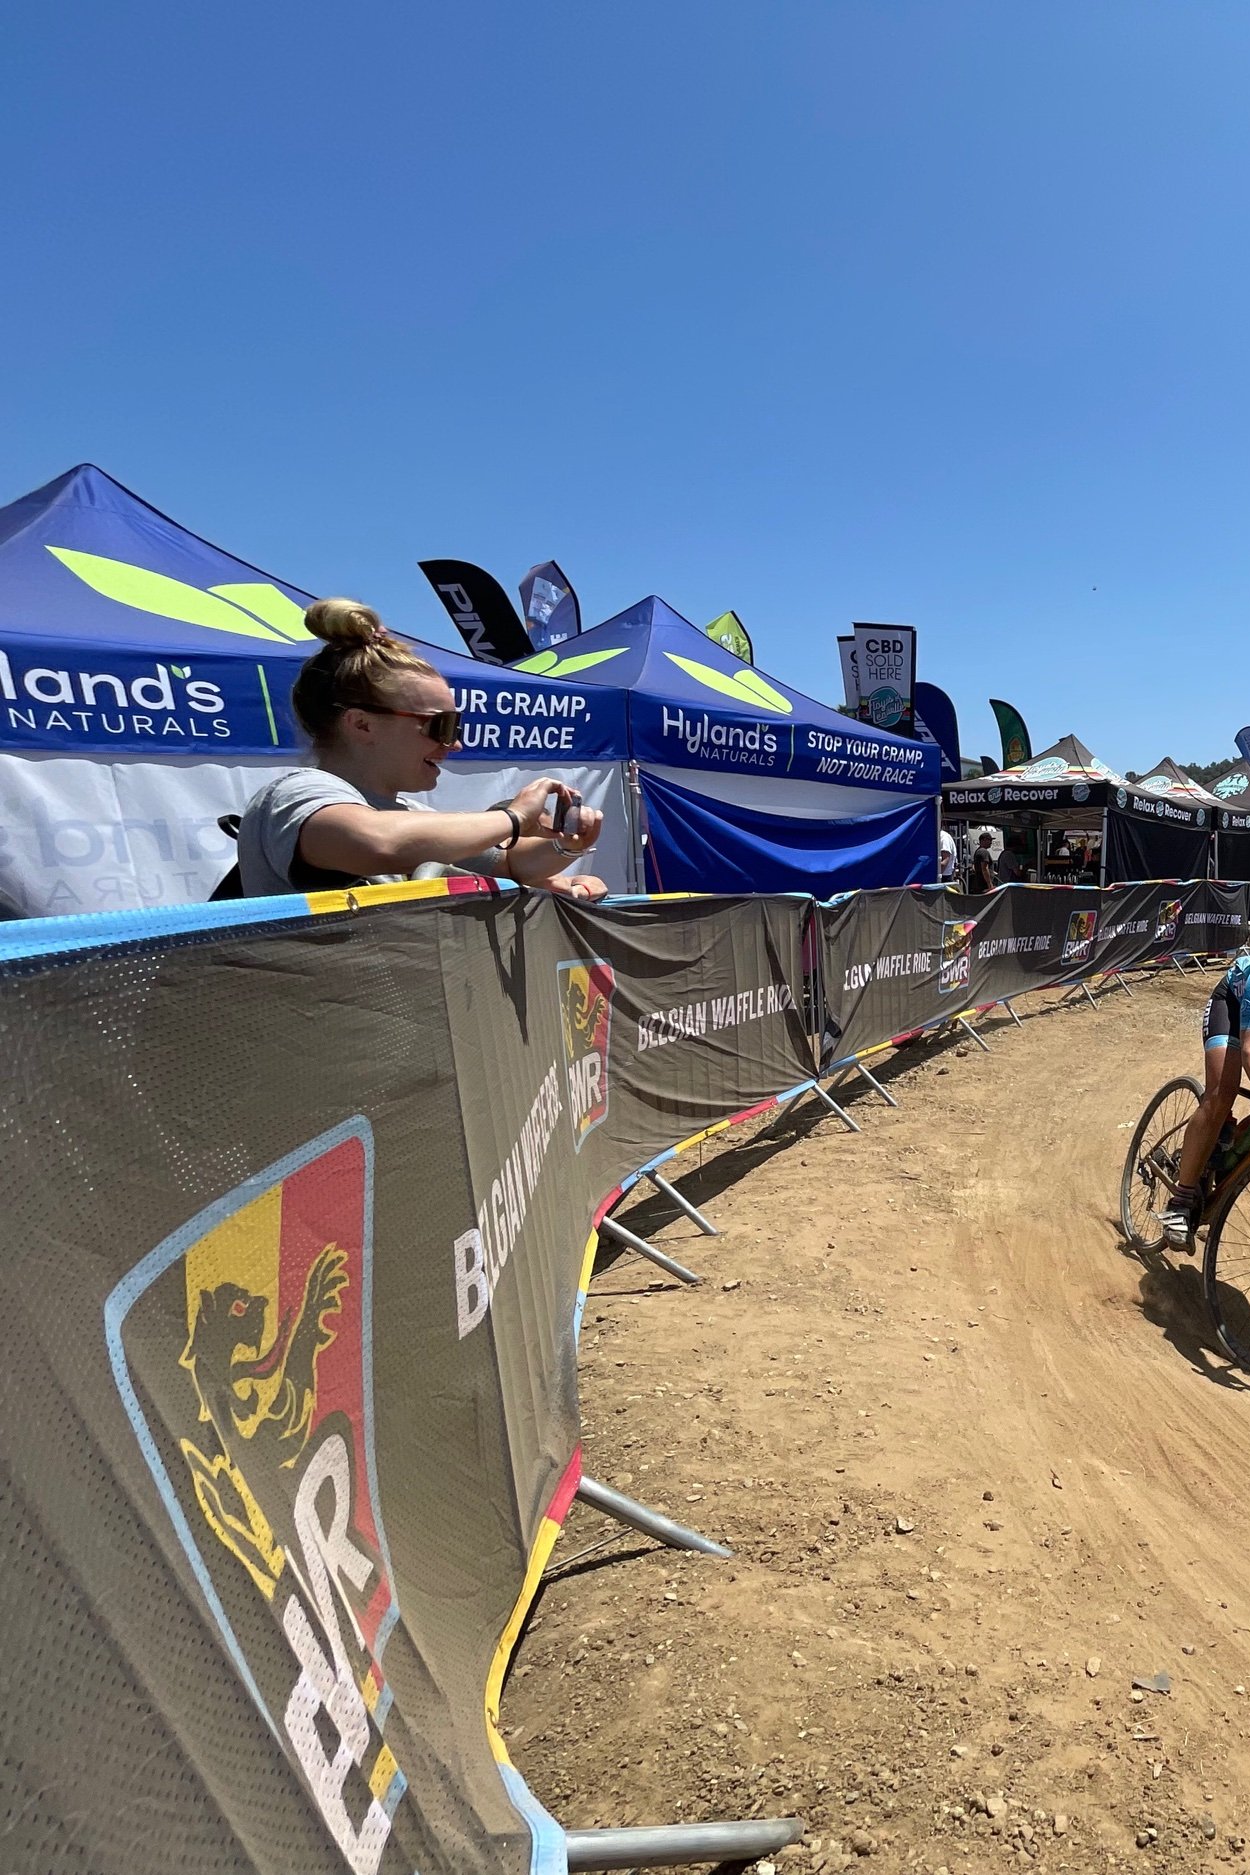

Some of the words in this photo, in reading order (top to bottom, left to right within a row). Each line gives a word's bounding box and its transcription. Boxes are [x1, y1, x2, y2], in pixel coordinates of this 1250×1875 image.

[865, 639, 904, 654] CBD
[865, 654, 904, 667] SOLD
[868, 667, 902, 681] HERE
[450, 688, 488, 714] UR
[496, 691, 591, 723] CRAMP,
[8, 707, 231, 738] NATURALS
[463, 723, 500, 748] UR
[508, 724, 575, 750] RACE
[807, 730, 843, 753] STOP
[845, 738, 880, 760] YOUR
[882, 745, 925, 769] CRAMP,
[700, 746, 776, 767] NATURALS
[816, 756, 848, 776] NOT
[848, 761, 882, 781] YOUR
[881, 766, 916, 785] RACE
[949, 789, 986, 805] Relax
[1004, 788, 1059, 802] Recover
[1133, 796, 1155, 813] Relax
[1165, 802, 1192, 822] Recover
[1185, 912, 1207, 925] BELGIAN
[1207, 913, 1231, 925] WAFFLE
[1230, 914, 1242, 925] RIDE
[978, 939, 1007, 959] BELGIAN
[1007, 936, 1035, 954] WAFFLE
[1034, 935, 1052, 951] RIDE
[875, 953, 911, 980] WAFFLE
[913, 951, 932, 974] RIDE
[637, 1001, 707, 1052] BELGIAN
[711, 987, 764, 1031] WAFFLE
